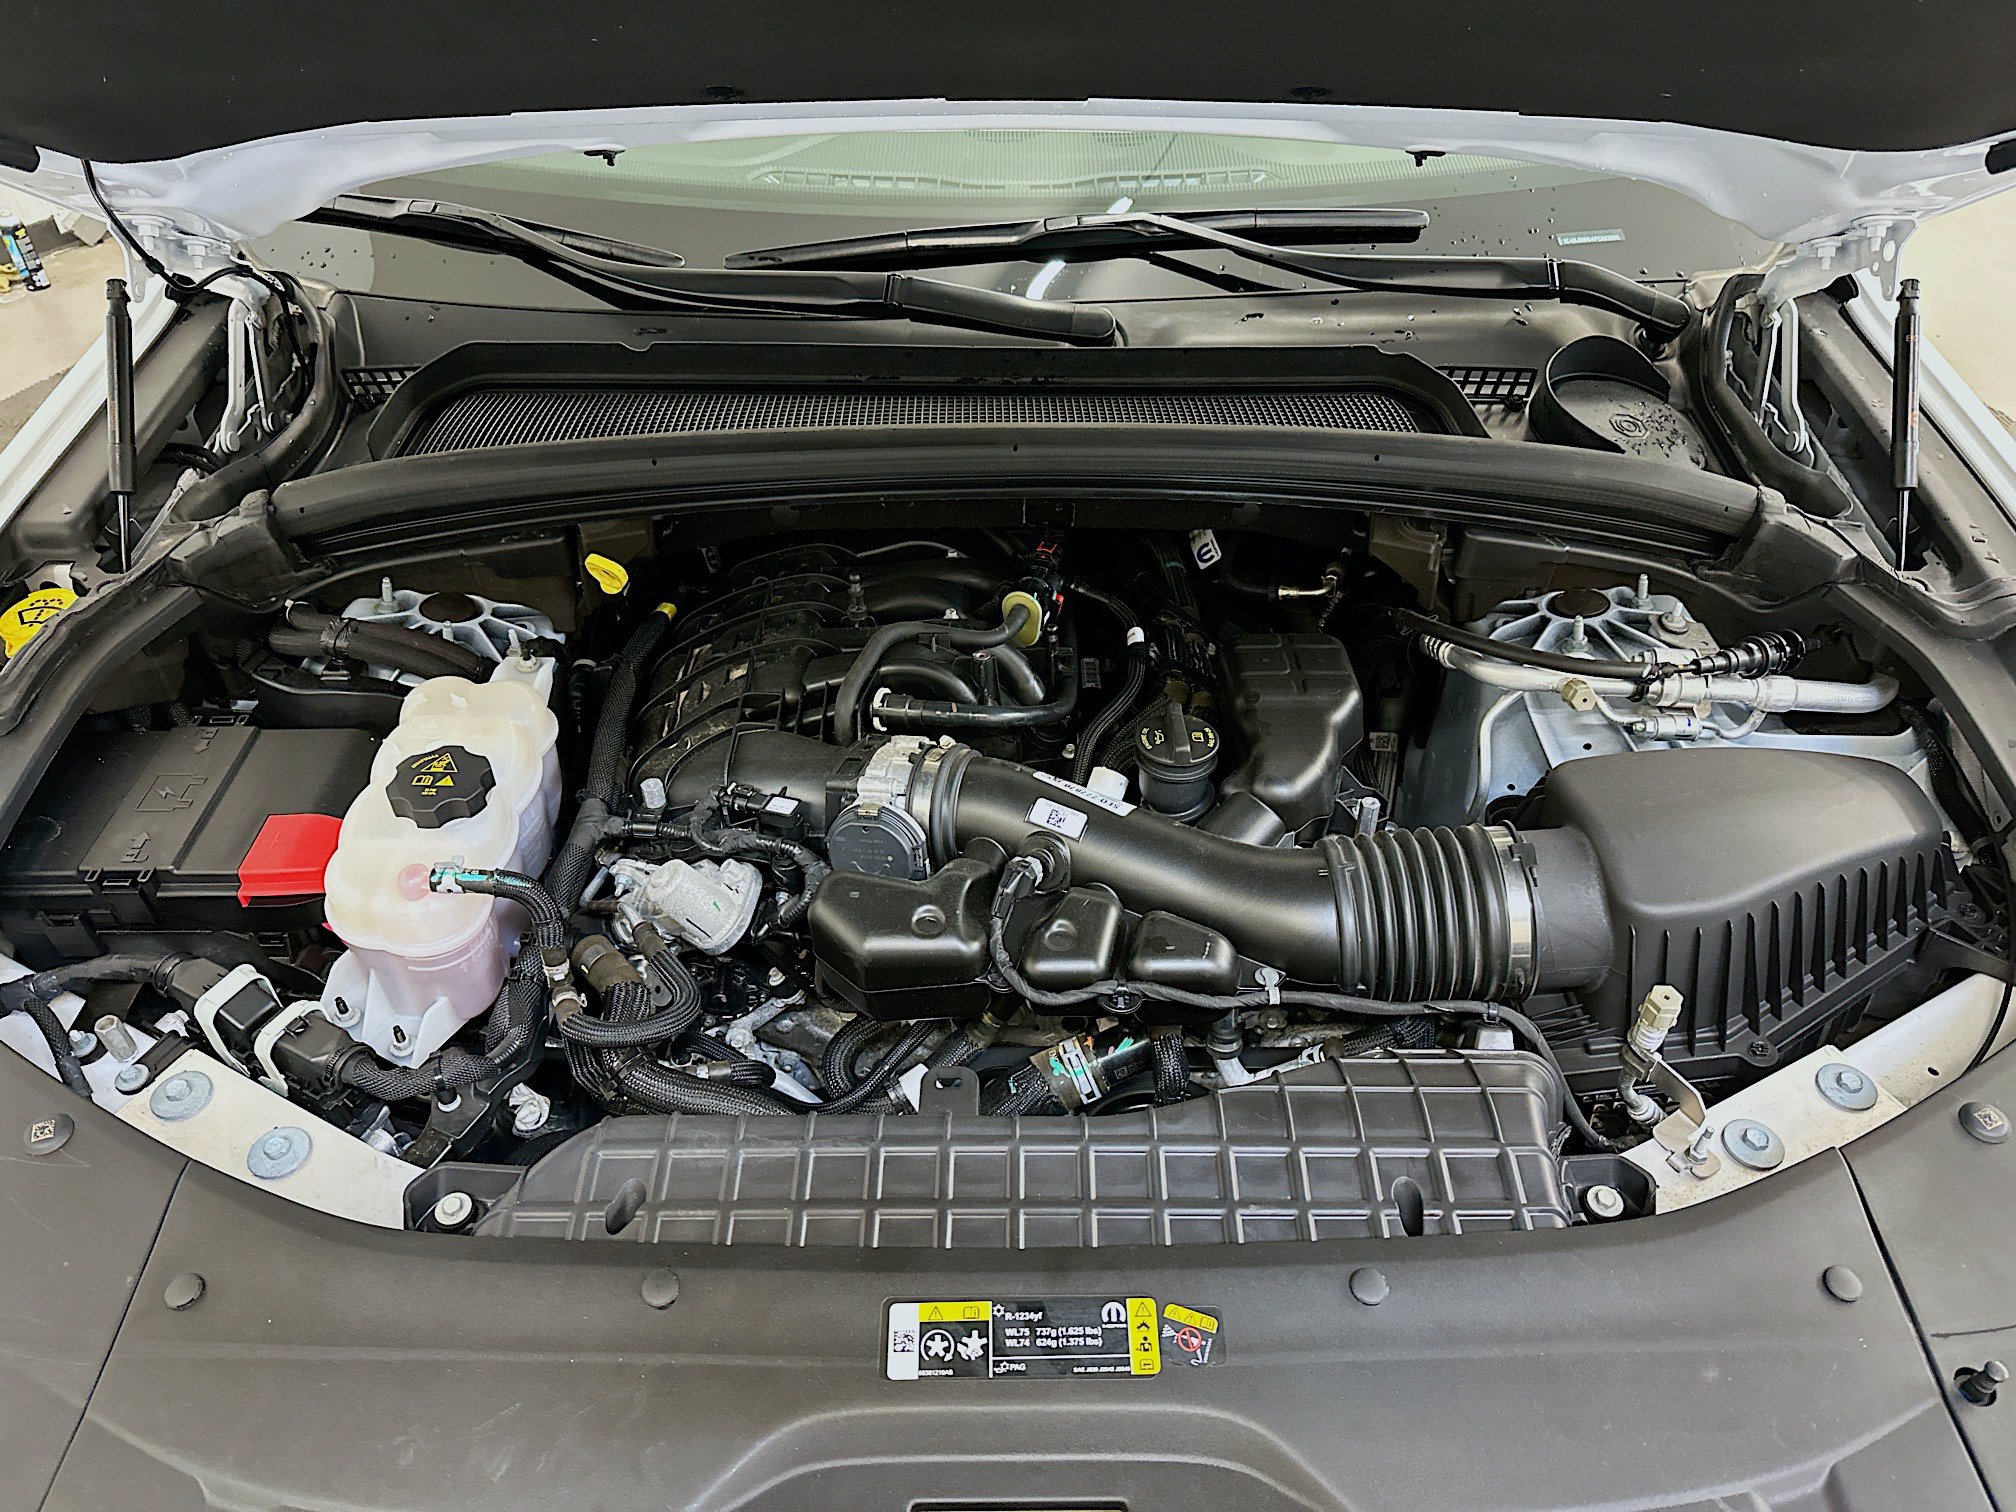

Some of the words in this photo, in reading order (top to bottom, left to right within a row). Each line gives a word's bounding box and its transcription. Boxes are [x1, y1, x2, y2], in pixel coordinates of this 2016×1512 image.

[1004, 1311, 1043, 1322] R-1234yf
[1004, 1327, 1030, 1337] WL75
[1035, 1327, 1057, 1338] 737g
[1058, 1326, 1084, 1337] (1.625
[1085, 1326, 1102, 1337] lbs)
[1004, 1338, 1030, 1348] WL74
[1035, 1337, 1058, 1349] 624g
[1058, 1337, 1085, 1348] (1.375
[1085, 1336, 1103, 1348] lbs)
[1009, 1363, 1027, 1371] PAG
